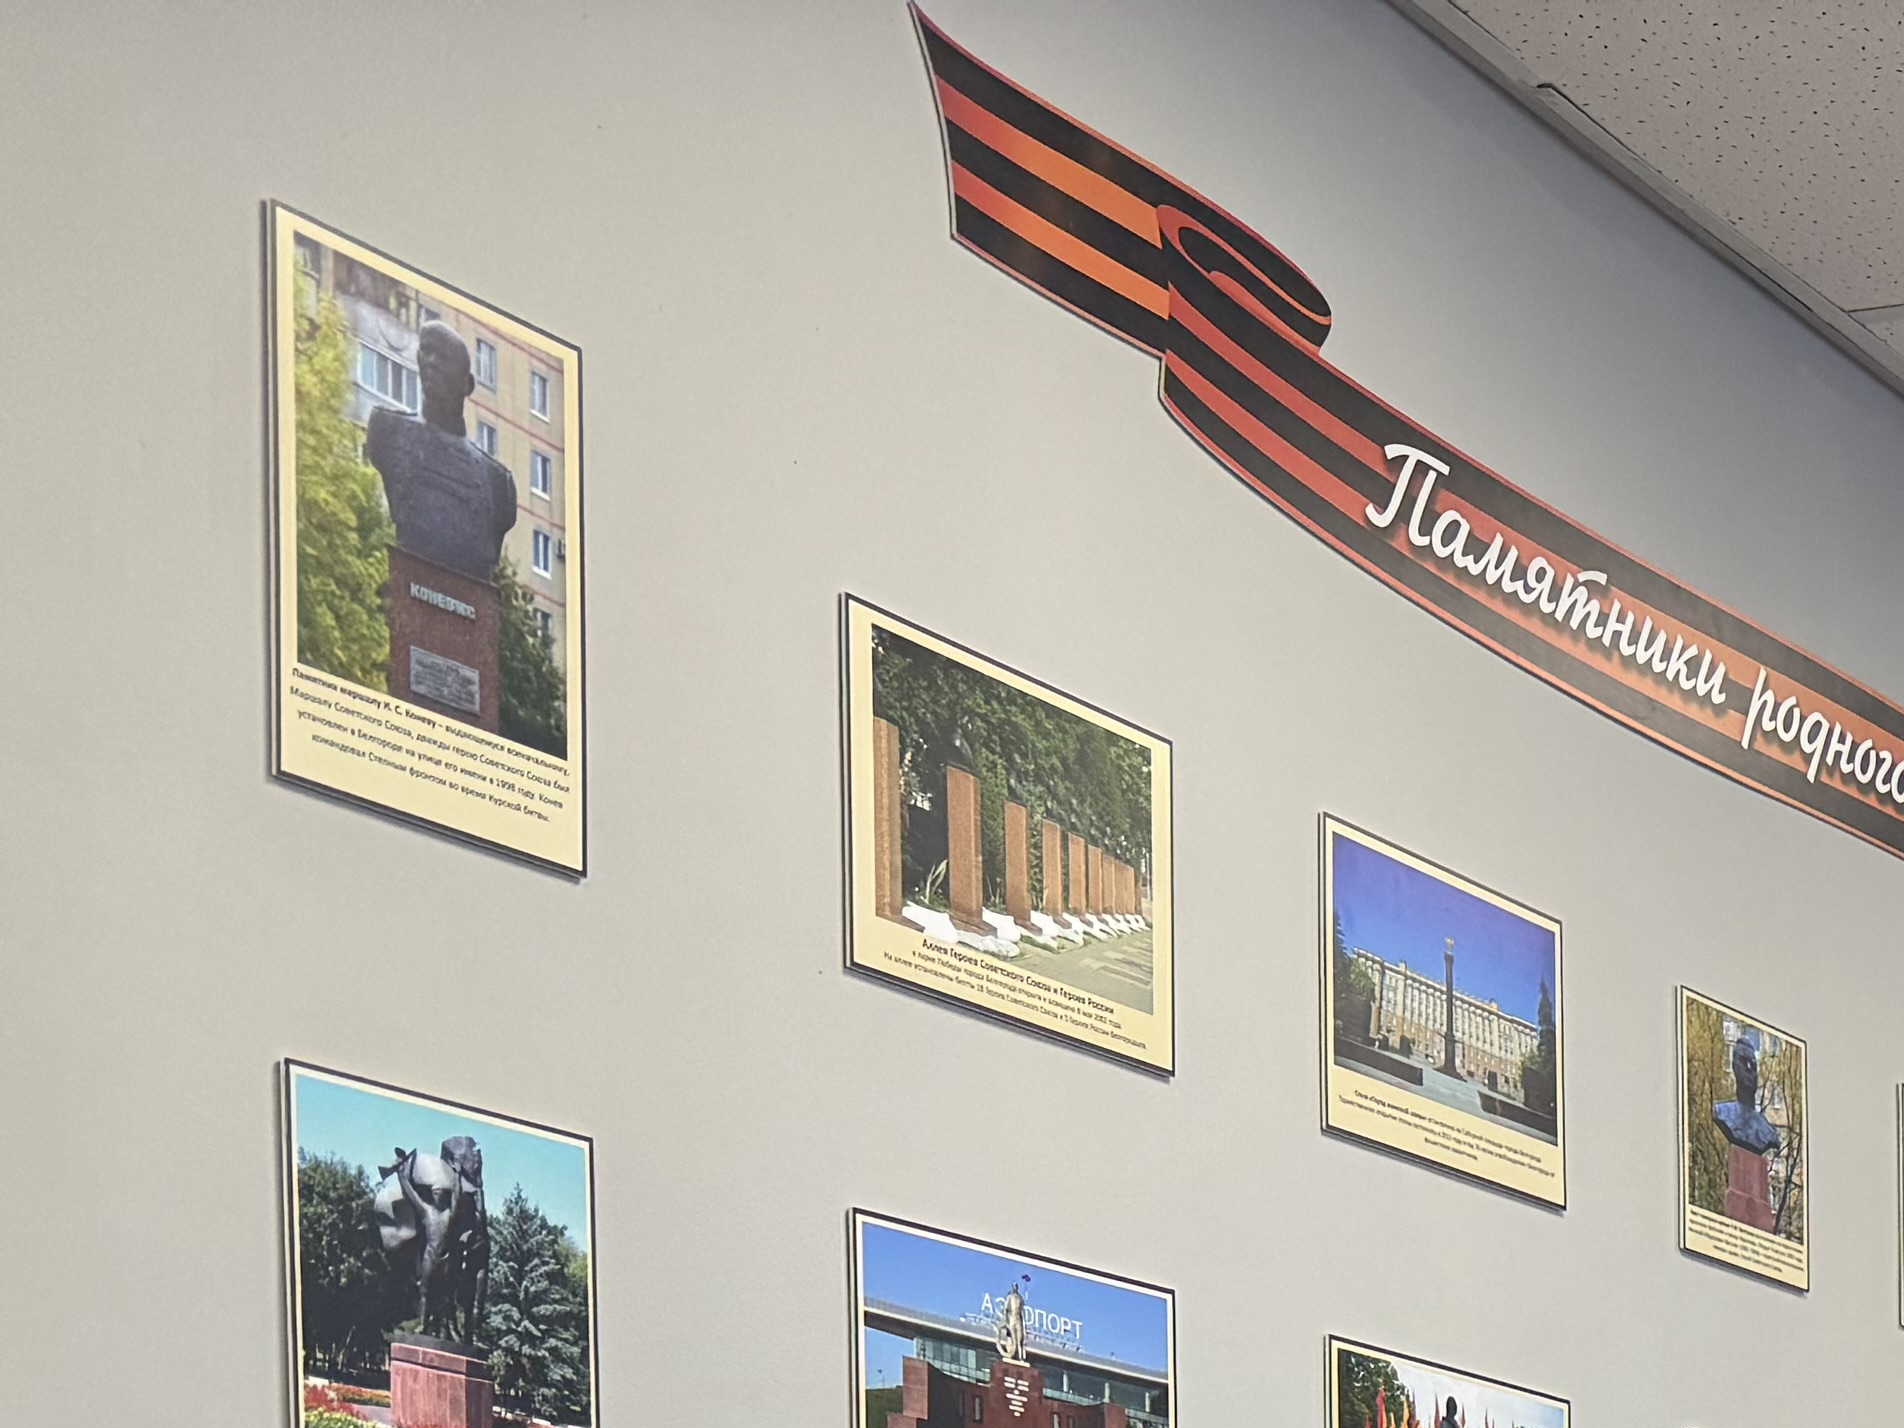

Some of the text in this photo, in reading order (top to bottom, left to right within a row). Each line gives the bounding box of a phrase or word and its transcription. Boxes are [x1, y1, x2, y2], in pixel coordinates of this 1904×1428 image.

[1365, 443, 1728, 706] Памятники
[335, 701, 382, 727] Советского
[480, 752, 525, 777] Советского
[922, 938, 948, 956] Аллея
[950, 947, 977, 966] Героев
[981, 958, 1024, 982] Советского
[1026, 974, 1051, 992] Союза
[1060, 986, 1085, 1004] Героев
